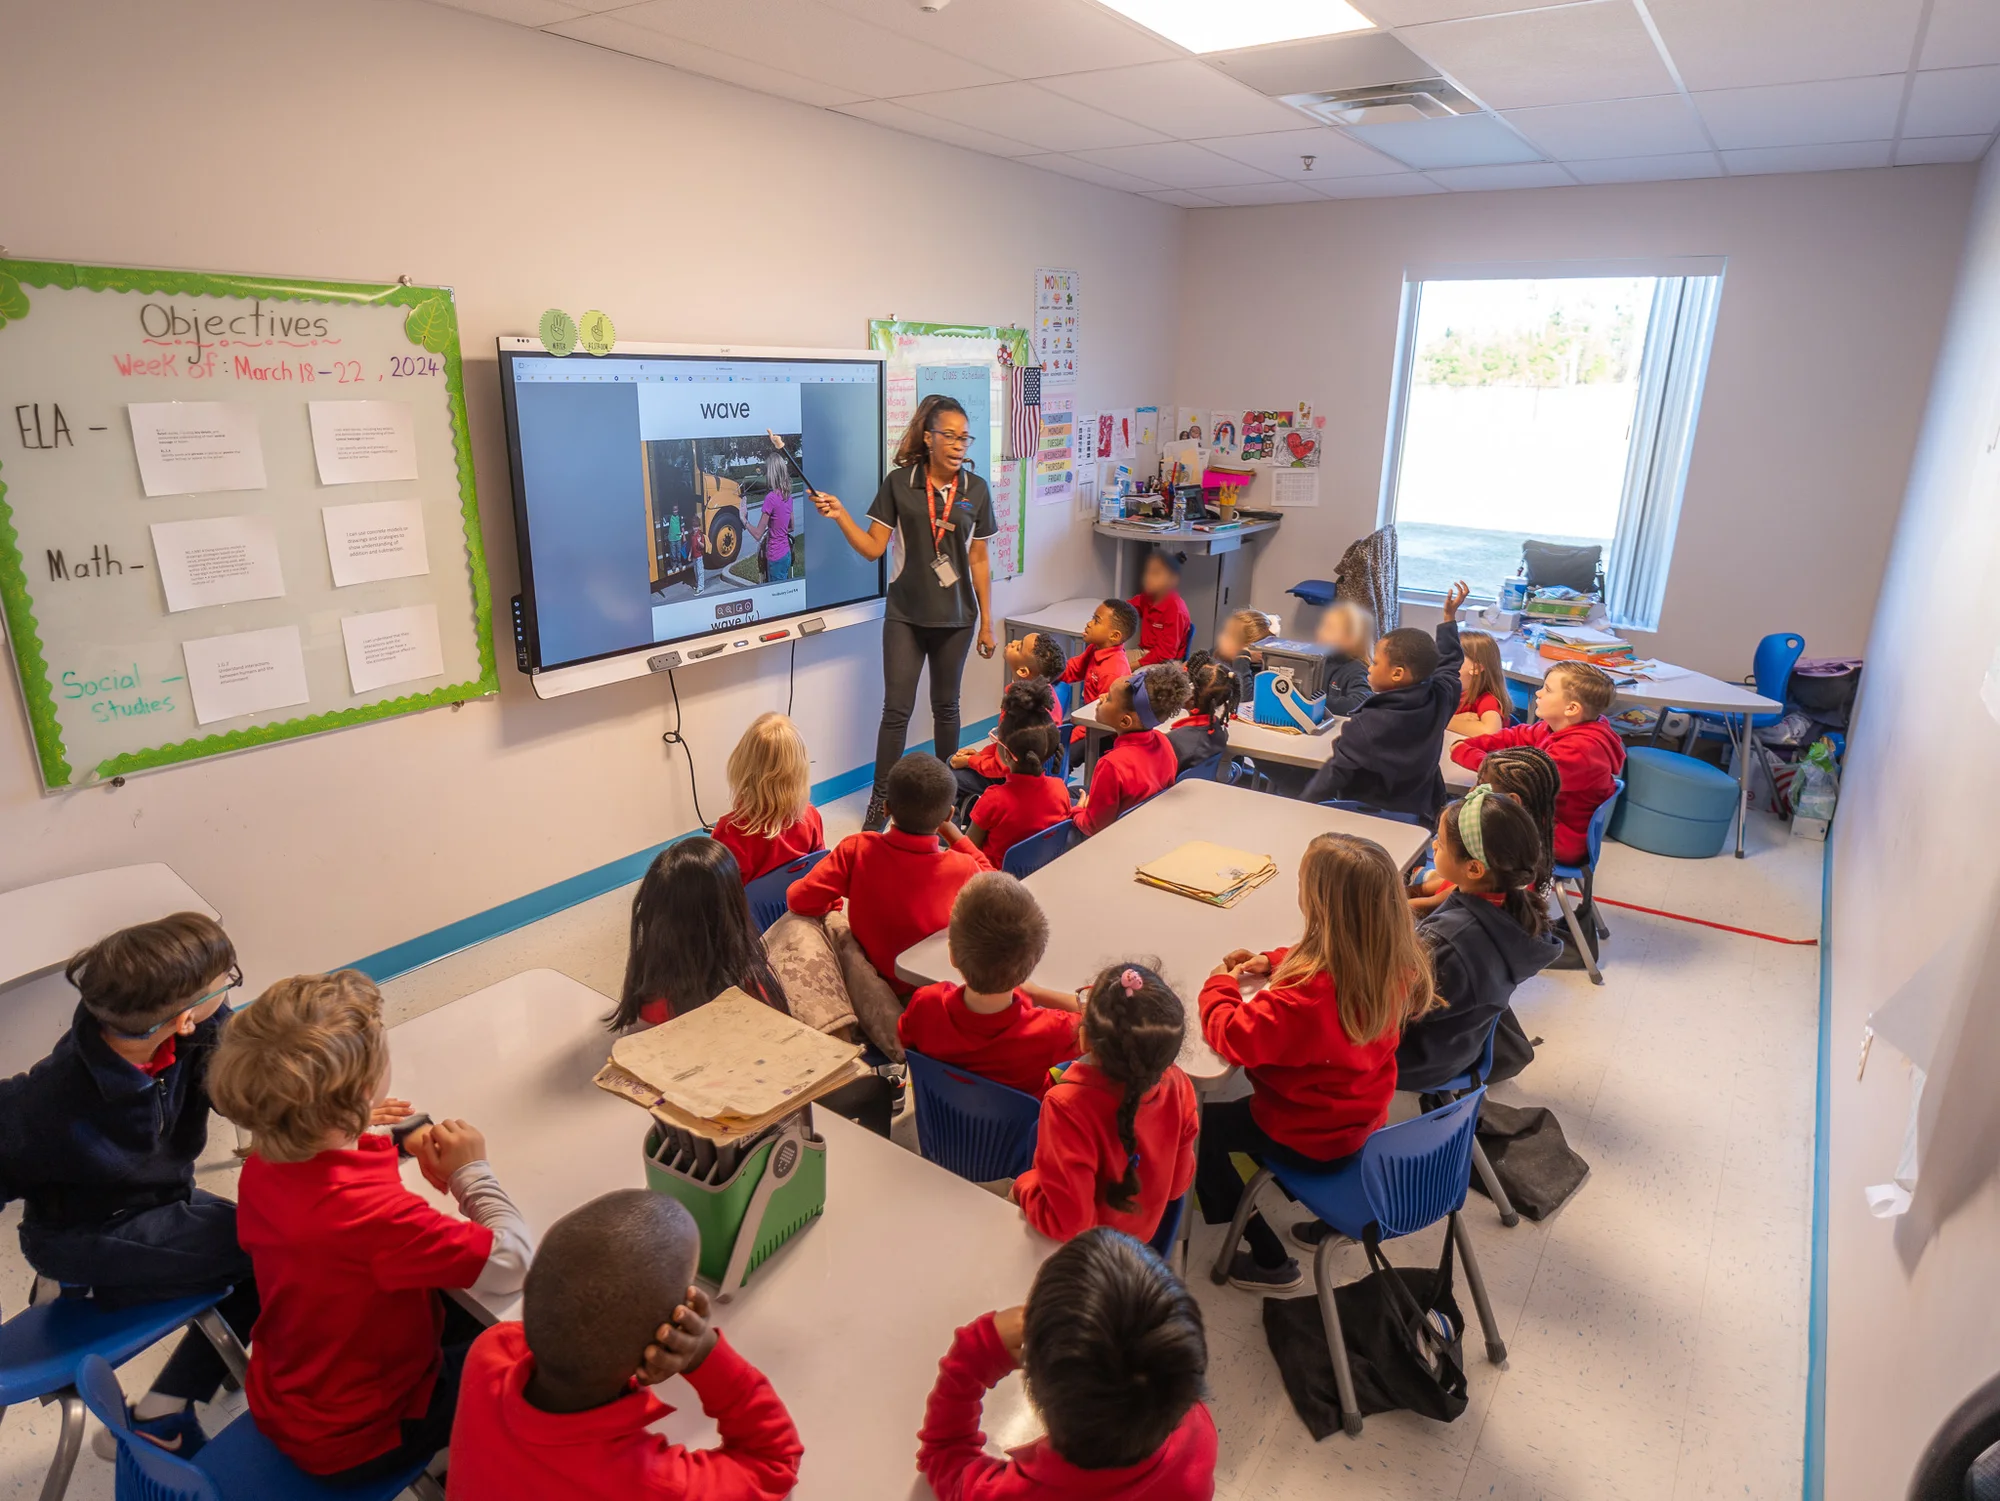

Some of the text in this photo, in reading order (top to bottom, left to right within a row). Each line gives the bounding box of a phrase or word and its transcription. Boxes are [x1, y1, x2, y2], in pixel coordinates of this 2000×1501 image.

[1044, 274, 1071, 290] MONTHS
[139, 300, 329, 365] Objectives
[113, 353, 178, 377] Week
[234, 355, 292, 381] March
[390, 356, 439, 377] 2024
[700, 402, 750, 419] wave
[15, 403, 74, 449] ELA
[1048, 415, 1064, 424] SUNDAY
[1048, 426, 1064, 436] MONDAY
[1047, 438, 1064, 448] TUESDAY
[1045, 462, 1065, 472] THURSDAY
[1048, 474, 1062, 482] FRIDAY
[1044, 485, 1064, 496] SATURDAY
[711, 617, 741, 631] wave
[62, 662, 141, 699] Social
